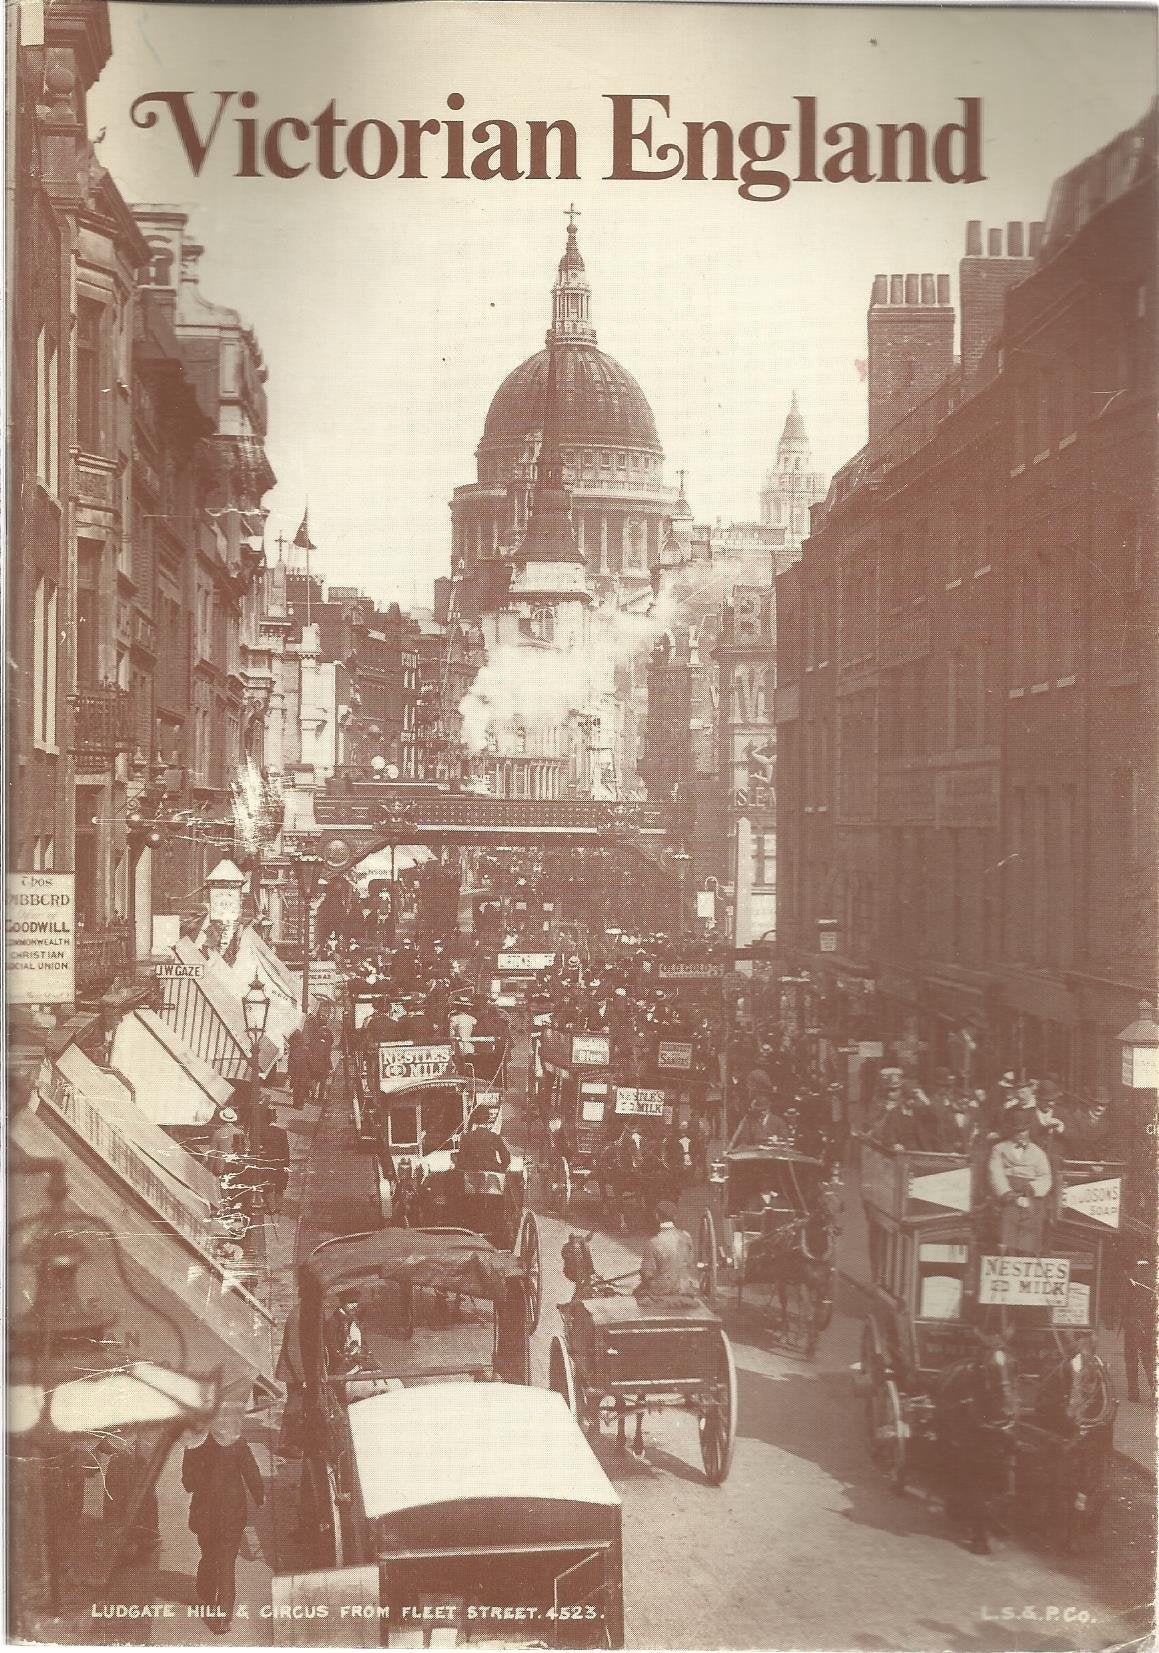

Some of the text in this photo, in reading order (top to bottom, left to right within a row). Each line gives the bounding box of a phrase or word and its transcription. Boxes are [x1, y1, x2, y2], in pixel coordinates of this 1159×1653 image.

[8, 938, 70, 946] MMONWEALTH
[11, 951, 64, 959] CHRISTIAN
[8, 961, 68, 970] OCIAL UNION
[175, 965, 201, 977] GAZE
[409, 1062, 449, 1078] MILK
[637, 1102, 662, 1114] MILK
[1018, 1280, 1065, 1296] MILK
